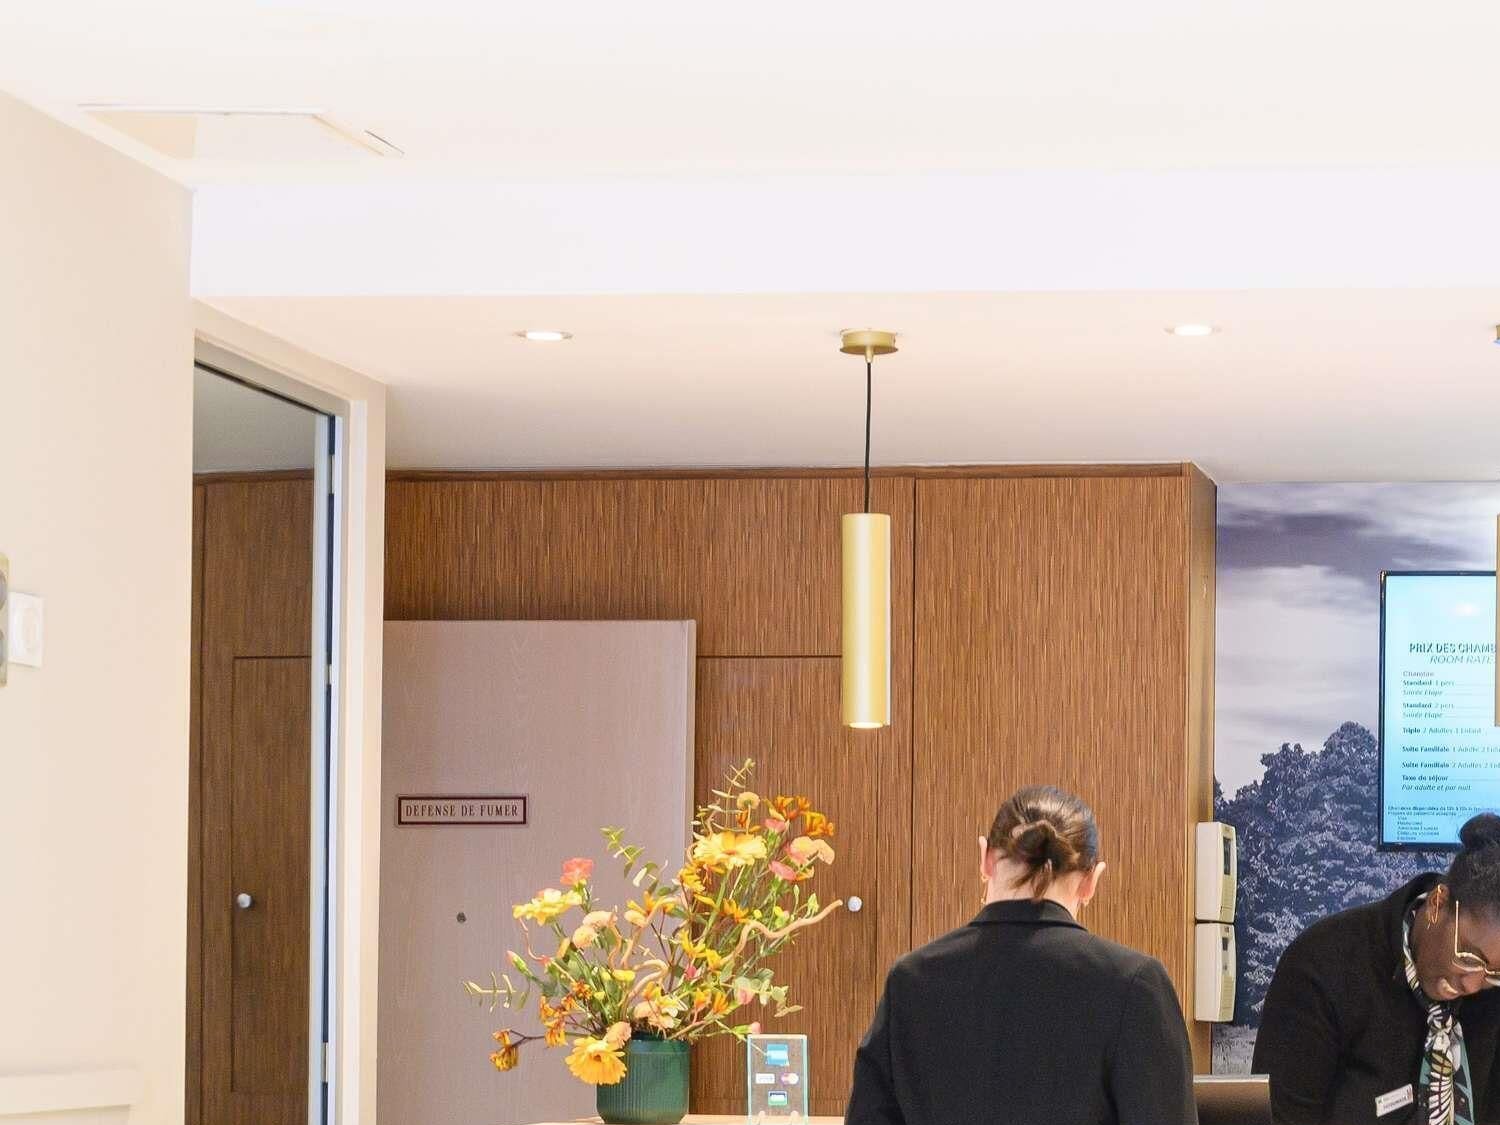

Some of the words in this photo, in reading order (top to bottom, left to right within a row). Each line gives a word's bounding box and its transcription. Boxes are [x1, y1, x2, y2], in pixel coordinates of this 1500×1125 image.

[1409, 643, 1433, 653] PRIX
[1436, 643, 1456, 653] DES
[1430, 655, 1463, 665] ROOM
[1466, 655, 1496, 665] RATE
[405, 804, 456, 817] DEFENSE
[461, 804, 476, 817] DE
[480, 804, 518, 817] FUMER
